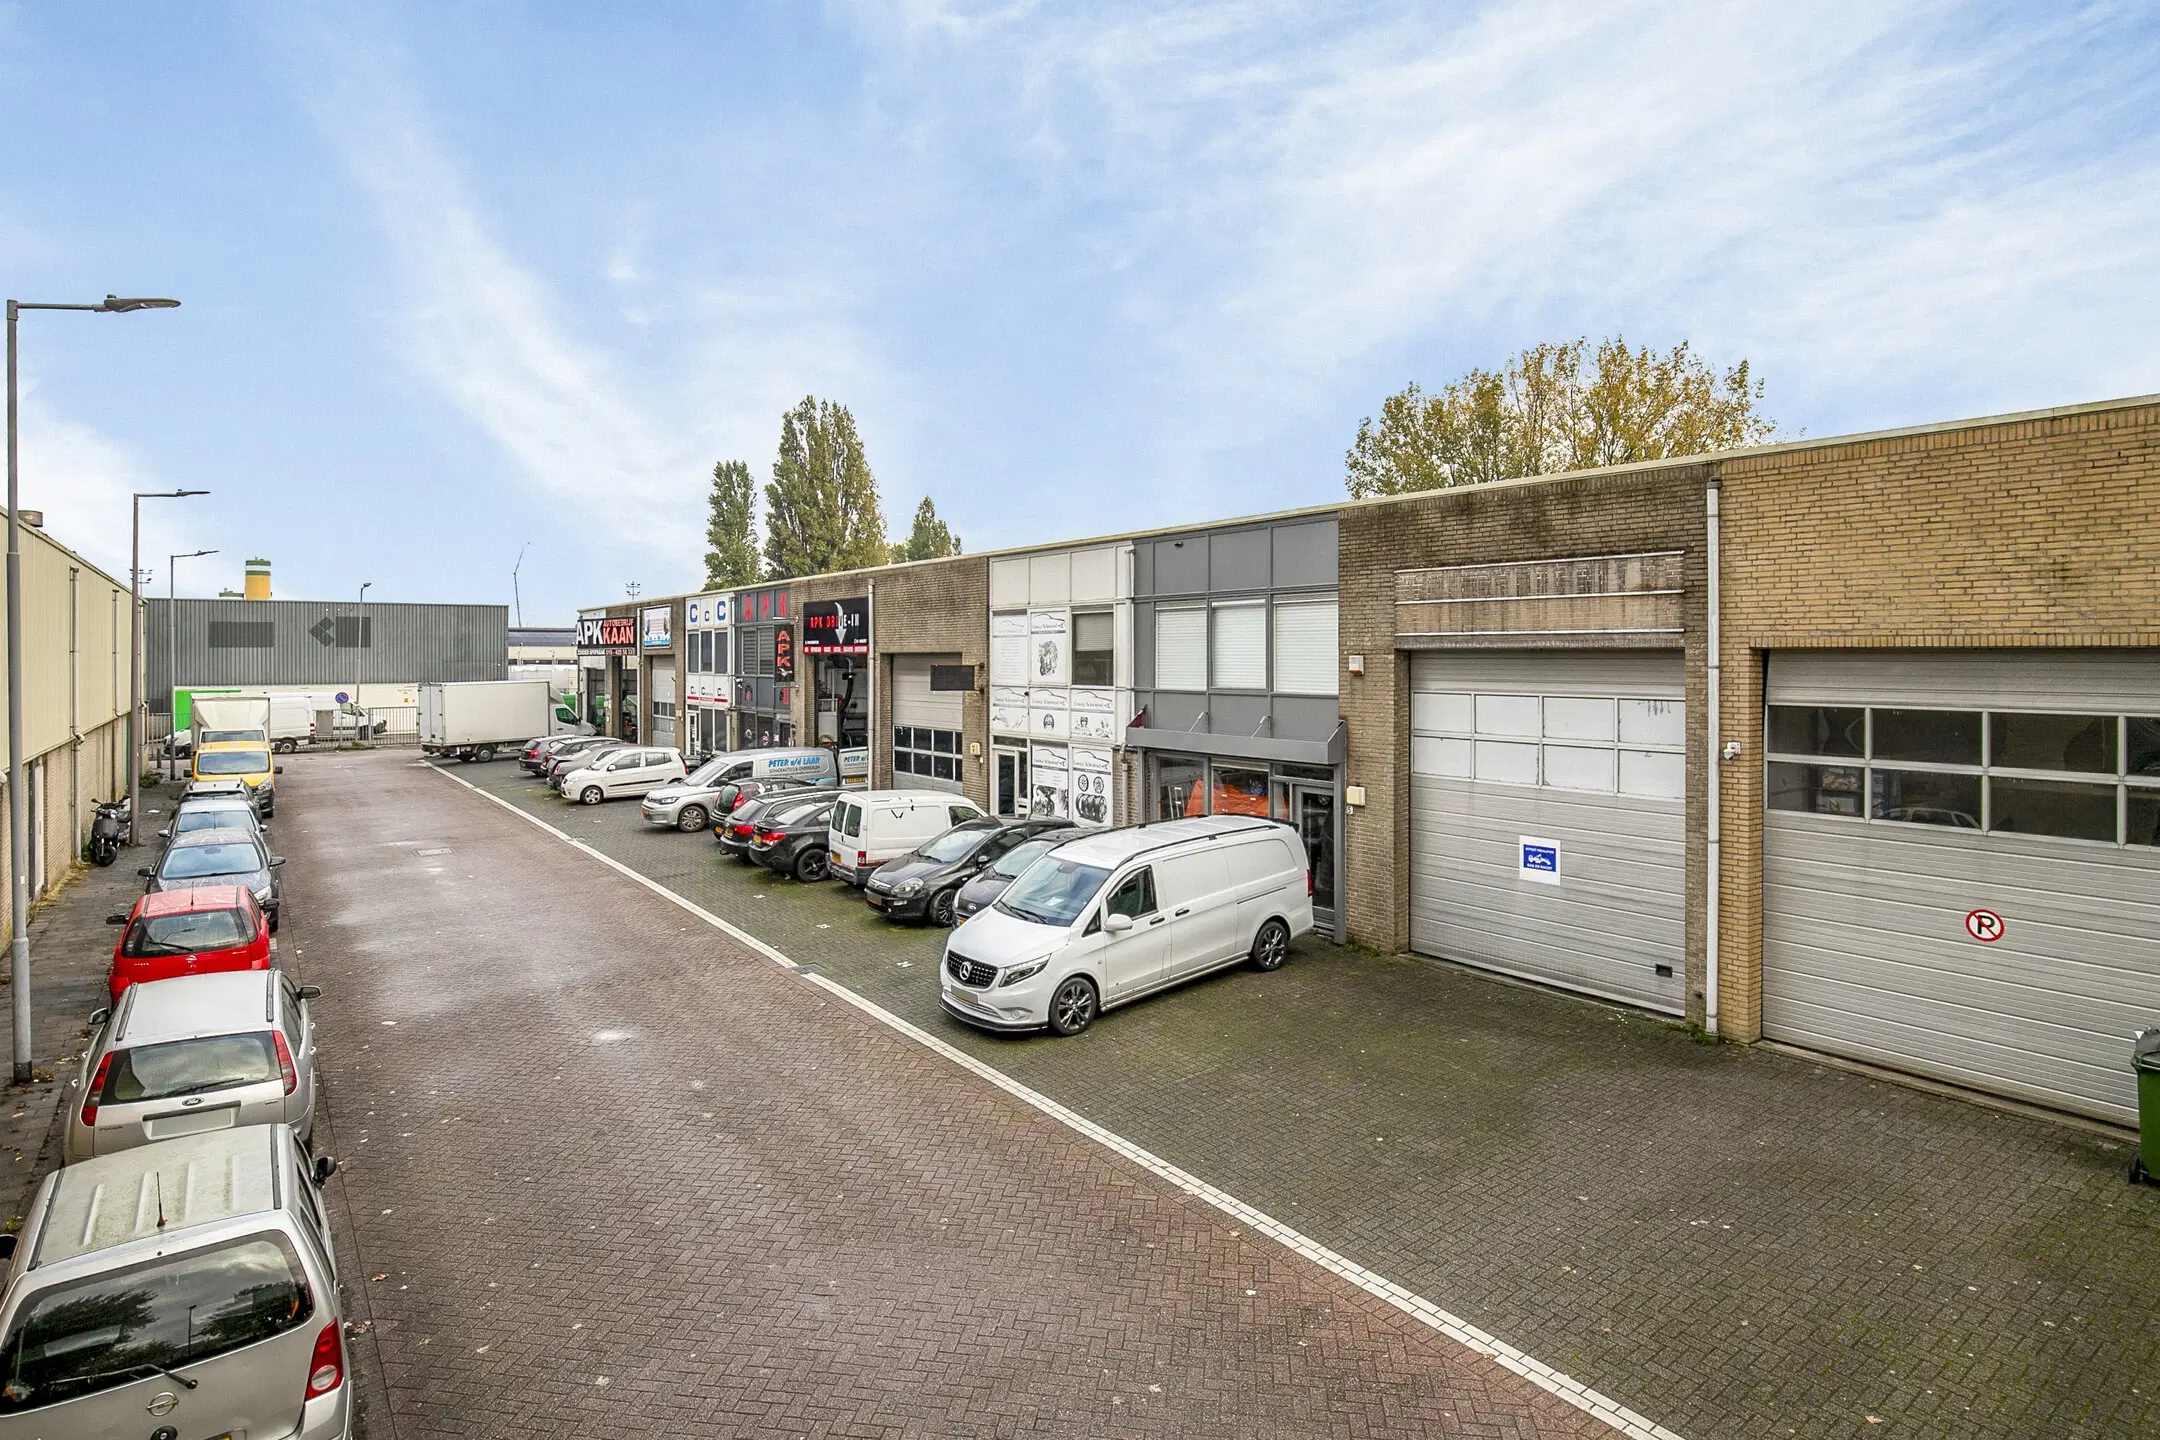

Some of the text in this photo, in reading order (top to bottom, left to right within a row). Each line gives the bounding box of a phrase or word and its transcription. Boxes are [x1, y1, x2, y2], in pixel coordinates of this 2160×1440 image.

[603, 619, 634, 627] AUTOBEDRIJF
[809, 616, 822, 628] APK
[576, 620, 603, 645] APK
[603, 626, 634, 645] KAAN
[777, 630, 791, 667] APK
[768, 758, 789, 767] PETER
[803, 756, 820, 765] LAAR
[844, 755, 860, 763] PETER
